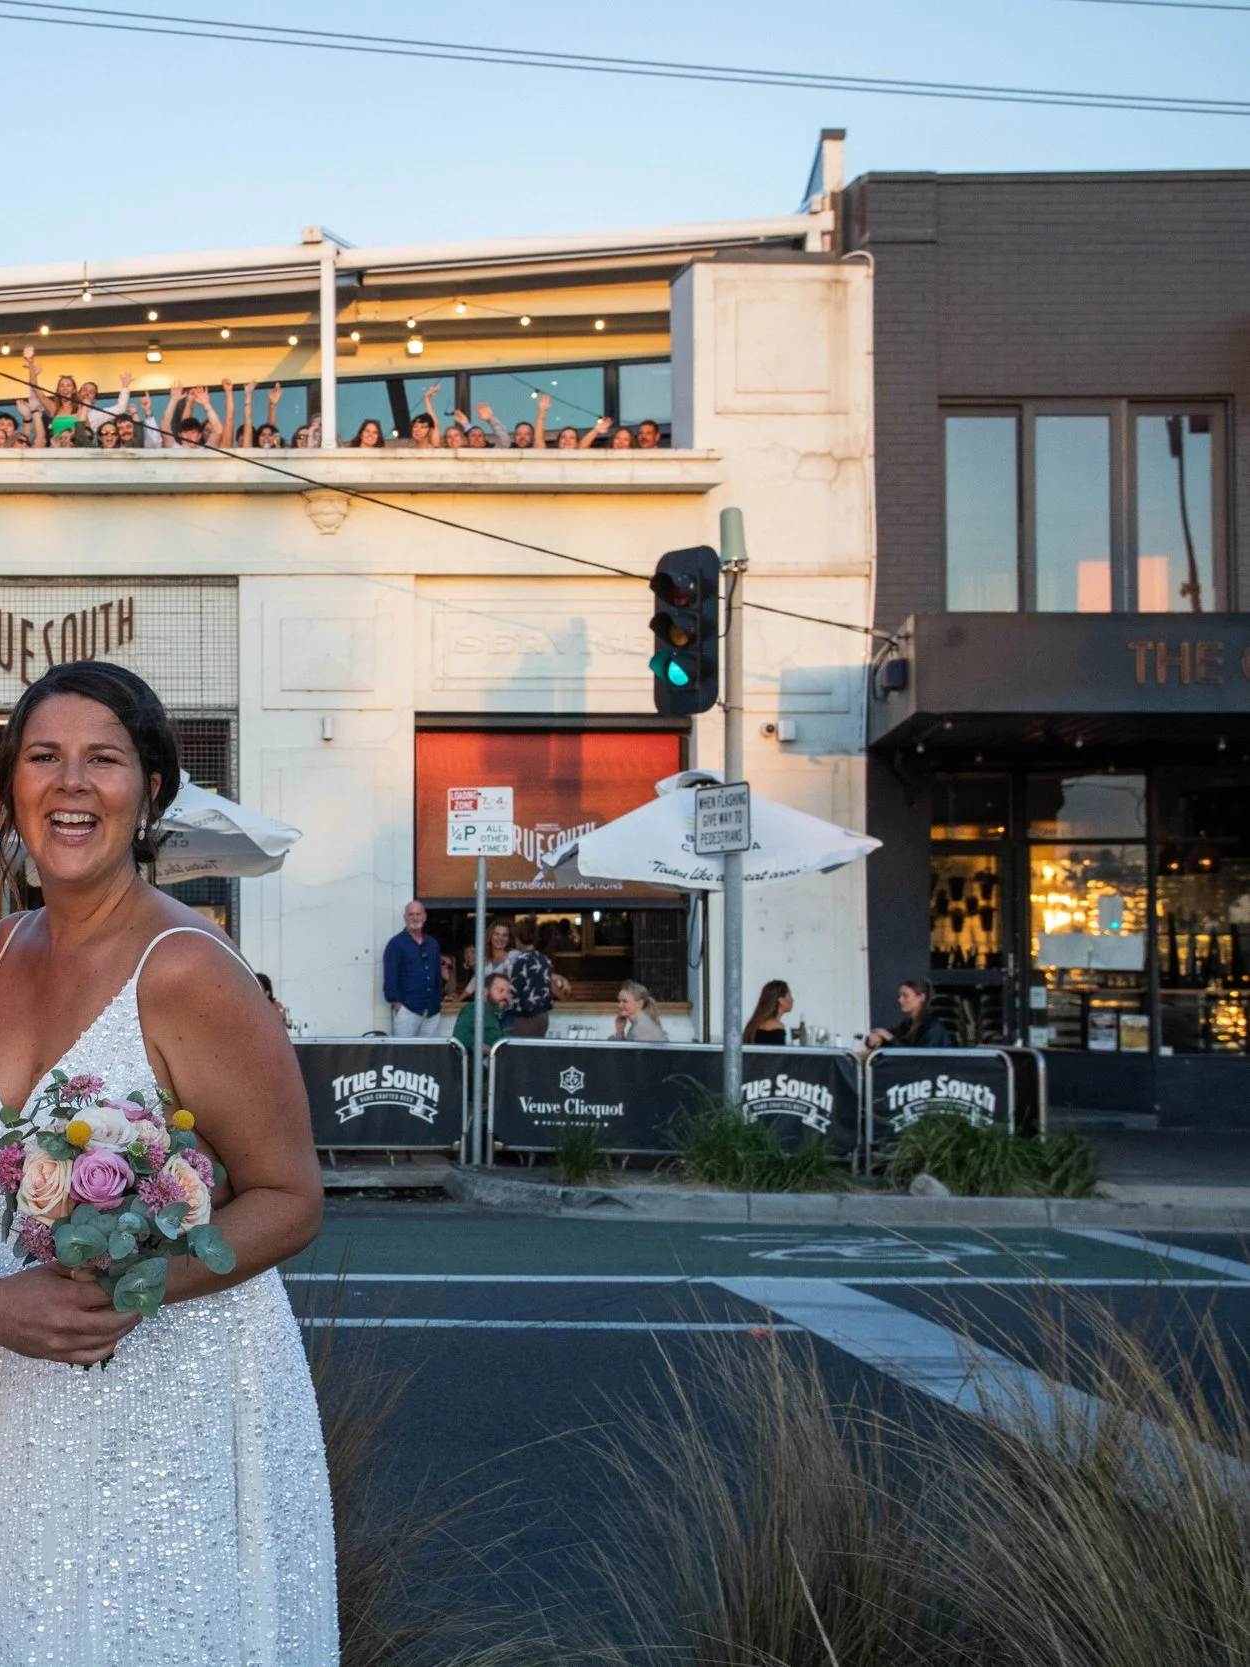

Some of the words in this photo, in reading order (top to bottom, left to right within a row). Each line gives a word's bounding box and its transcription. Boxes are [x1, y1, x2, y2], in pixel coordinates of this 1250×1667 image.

[1127, 641, 1225, 684] THE
[699, 795, 716, 810] WHEN
[716, 791, 747, 809] FLASHING
[702, 812, 718, 828] GIVE
[718, 811, 733, 827] WAY
[734, 810, 743, 824] TO
[486, 825, 505, 833] ALL
[701, 829, 743, 846] PEDESTRIANS
[480, 835, 509, 843] OTHER
[482, 844, 508, 853] TIMES
[690, 867, 714, 881] like
[332, 1069, 377, 1101] True
[381, 1065, 440, 1102] South
[774, 1074, 833, 1113] South
[886, 1080, 932, 1111] True
[935, 1074, 995, 1113] South
[518, 1096, 562, 1114] Veuve
[564, 1098, 625, 1119] Clicquot
